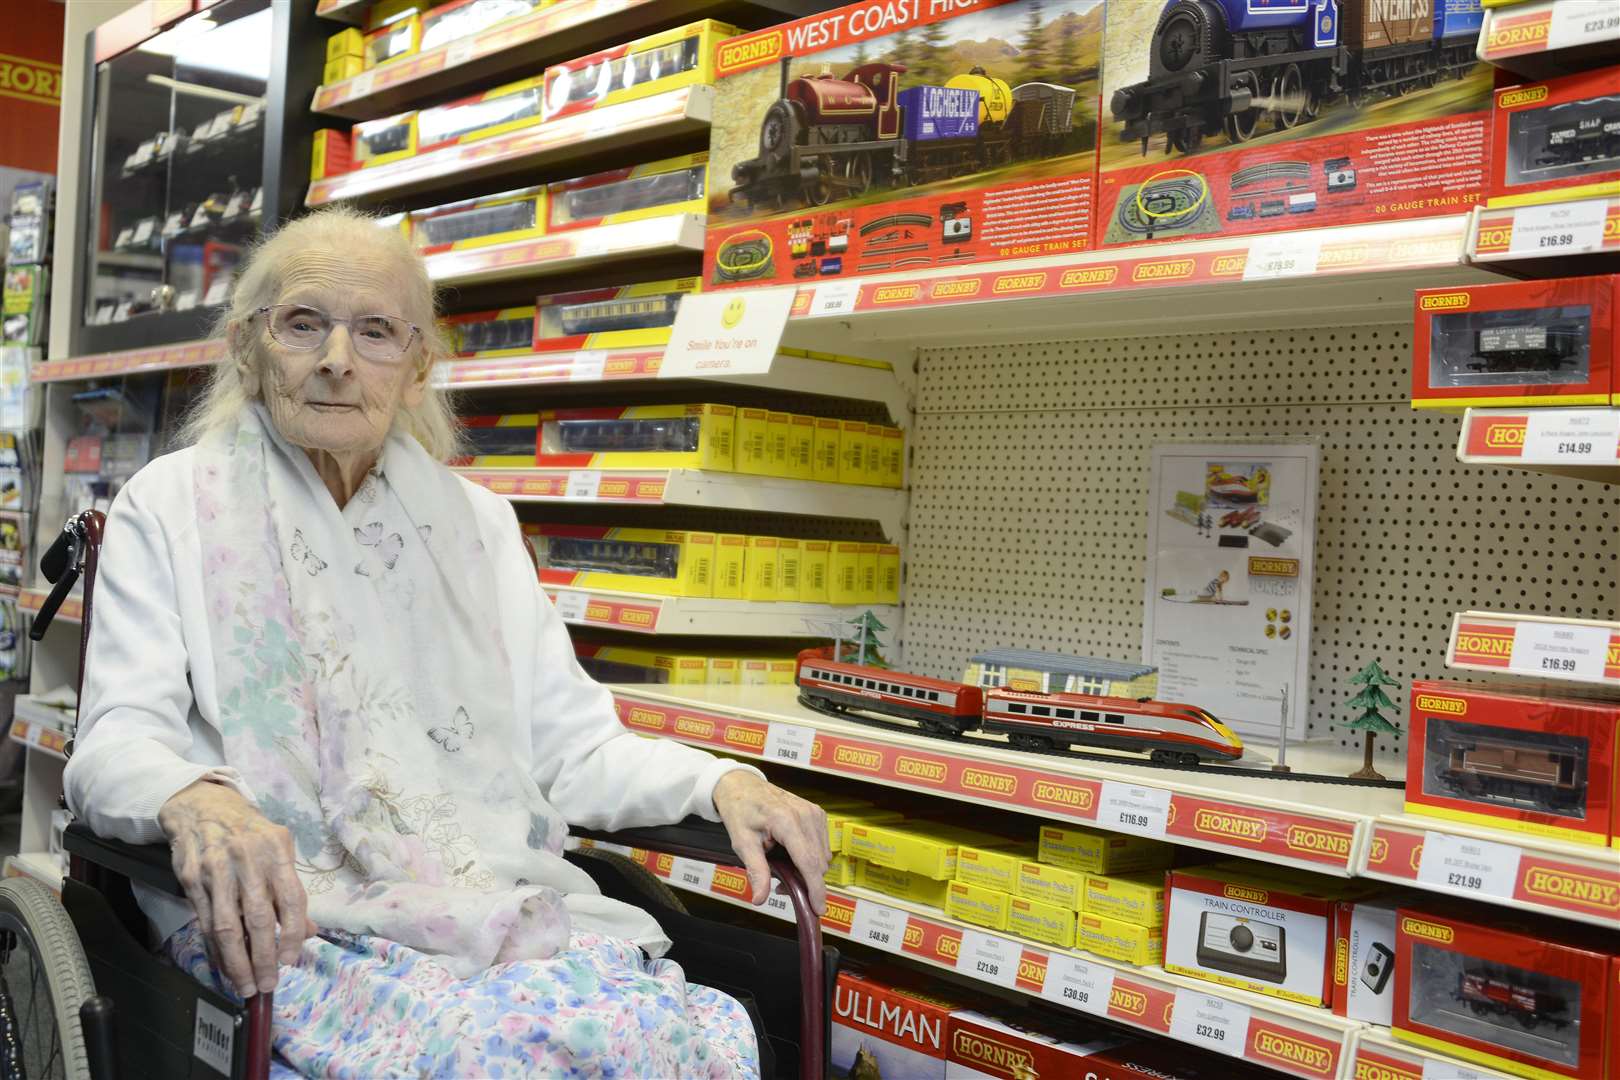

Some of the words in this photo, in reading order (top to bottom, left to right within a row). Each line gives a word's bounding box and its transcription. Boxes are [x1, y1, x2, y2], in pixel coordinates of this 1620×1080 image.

[787, 15, 845, 52] WEST
[848, 0, 923, 36] COAST
[723, 36, 778, 66] HORNBY
[922, 87, 976, 118] LOCHGELLY
[1502, 88, 1544, 106] HORNBY
[1390, 200, 1424, 212] GAUGE
[1428, 196, 1459, 207] TRAIN
[1463, 193, 1481, 202] SET
[1012, 243, 1041, 255] GAUGE
[1044, 241, 1069, 252] TRAIN
[1072, 239, 1089, 248] SET
[1540, 234, 1573, 247] £16.99
[1066, 270, 1112, 284] HORNBY
[1137, 263, 1191, 278] HORNBY
[934, 281, 977, 295] HORNBY
[997, 276, 1042, 290] HORNBY
[1423, 294, 1468, 308] HORNBY
[688, 340, 712, 351] Smile
[745, 339, 758, 348] on
[1558, 442, 1592, 454] £14.99
[1542, 657, 1576, 671] £16.99
[1420, 697, 1463, 712] HORNBY
[1052, 720, 1096, 732] EXPRESS
[727, 728, 765, 746] HORNBY
[838, 746, 878, 769] HORNBY
[899, 760, 942, 779] HORNBY
[965, 771, 1013, 792] HORNBY
[1038, 785, 1088, 806] HORNBY
[1120, 812, 1148, 827] £116.99
[1199, 809, 1262, 837] HORNBY
[1448, 872, 1482, 889] £21.99
[1533, 872, 1616, 903] HORNBY
[1227, 886, 1266, 902] HORNBY
[1204, 898, 1229, 912] TRAIN
[1230, 903, 1286, 922] CONTROLLER
[1405, 920, 1450, 940] HORNBY
[976, 960, 998, 976] £21.99
[835, 984, 941, 1049] ULLMAN
[1196, 1024, 1225, 1041] £32.99
[959, 1034, 1028, 1068] HORNBY
[1261, 1033, 1327, 1067] HORNBY
